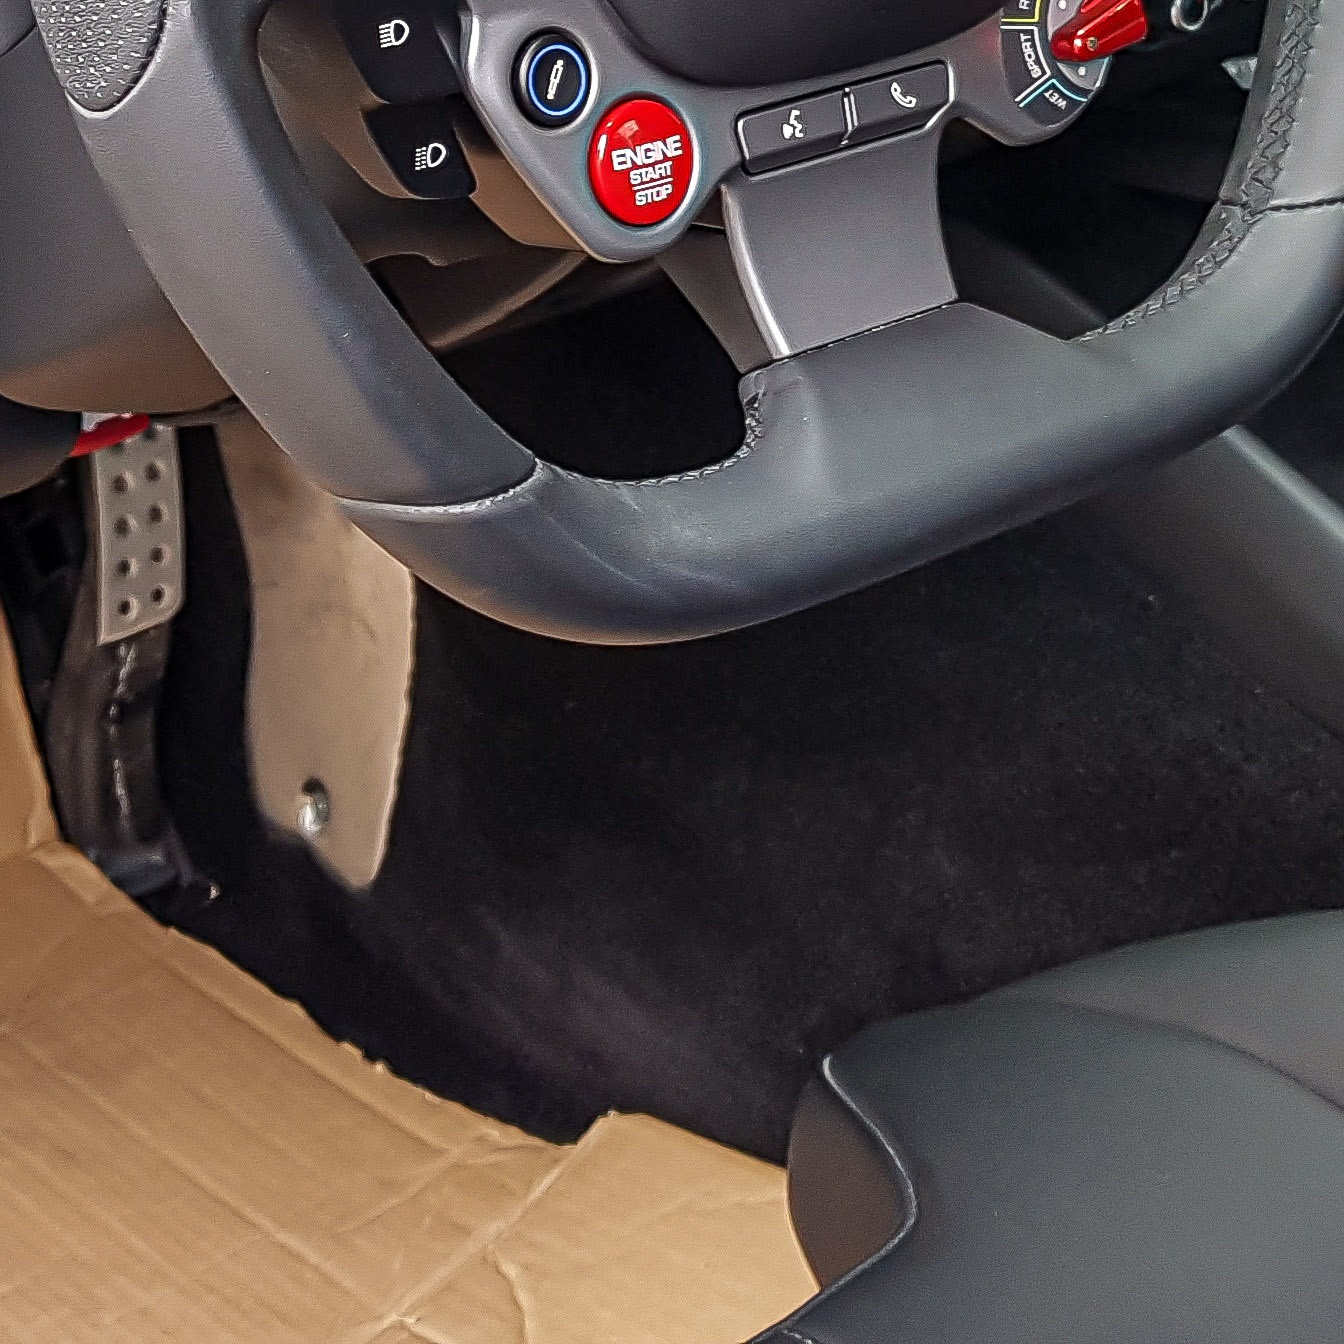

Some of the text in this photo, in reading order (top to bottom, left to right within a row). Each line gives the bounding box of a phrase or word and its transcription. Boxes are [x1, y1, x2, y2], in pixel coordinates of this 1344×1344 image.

[1019, 32, 1043, 79] SPORT
[1043, 88, 1068, 111] WET
[611, 134, 683, 171] ENGINE
[629, 160, 673, 185] START
[635, 183, 673, 206] STOP
